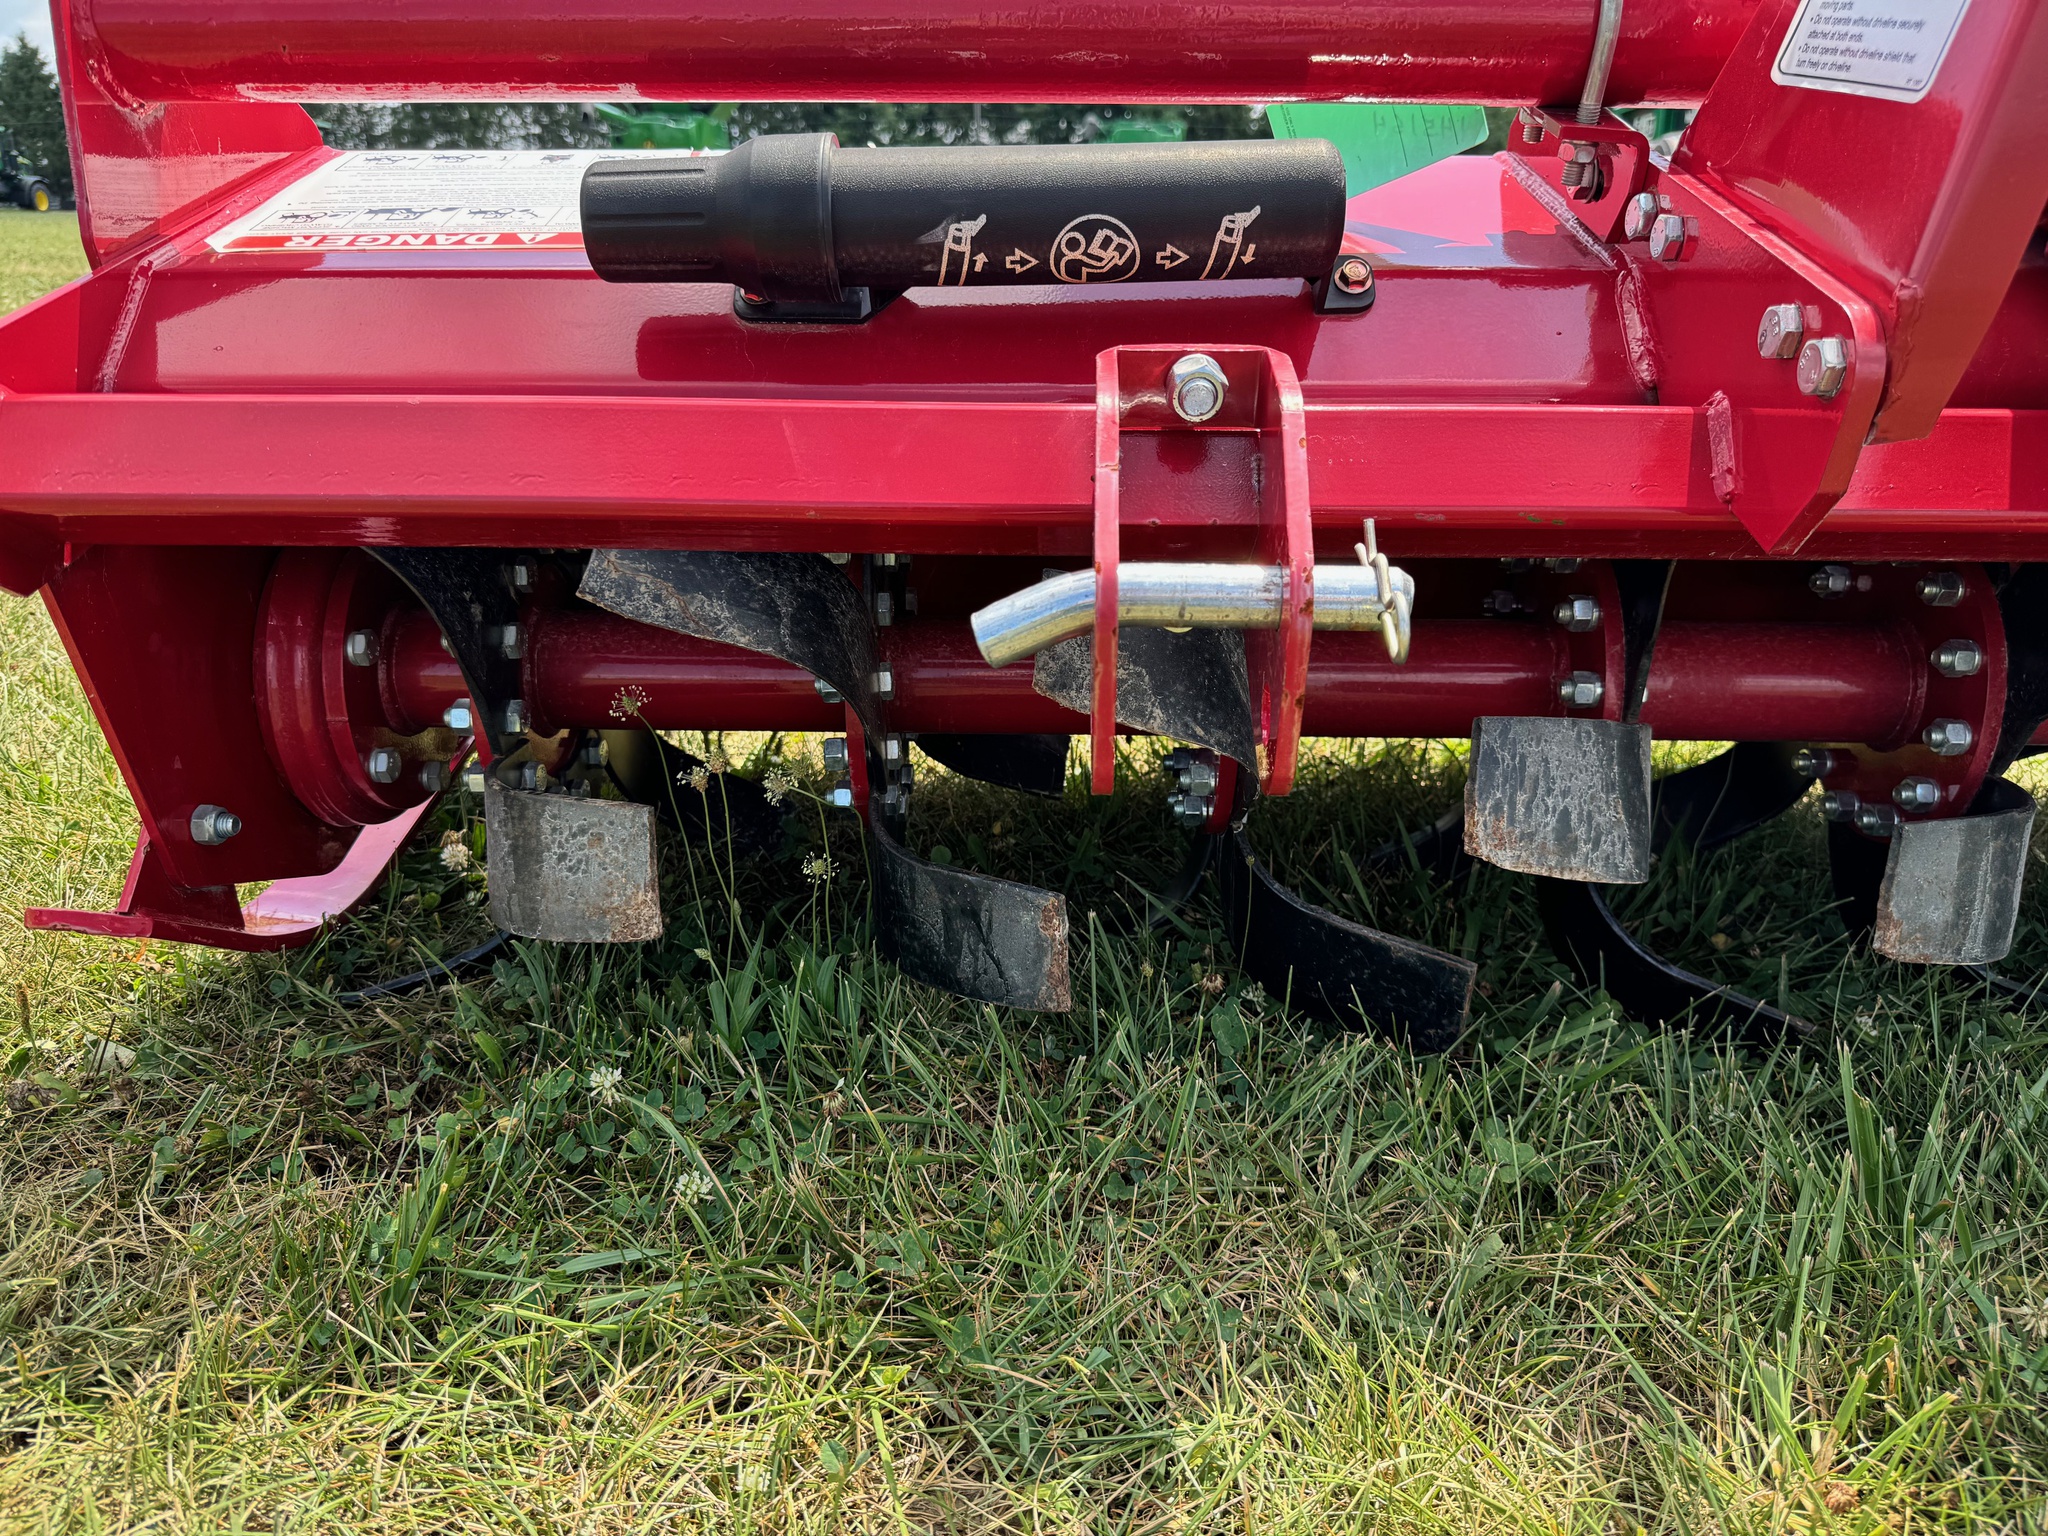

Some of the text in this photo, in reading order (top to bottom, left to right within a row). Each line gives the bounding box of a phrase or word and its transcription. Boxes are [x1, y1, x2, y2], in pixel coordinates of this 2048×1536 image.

[1813, 14, 1925, 33] Do not operate without driveline securely
[1807, 30, 1830, 41] attached
[1829, 31, 1837, 41] at
[1836, 31, 1848, 42] both
[1801, 43, 1916, 64] Do not operate without driveline shield that
[1796, 58, 1806, 68] turn
[1806, 58, 1820, 71] freely
[1820, 61, 1828, 70] on
[286, 232, 496, 247] DANGER
